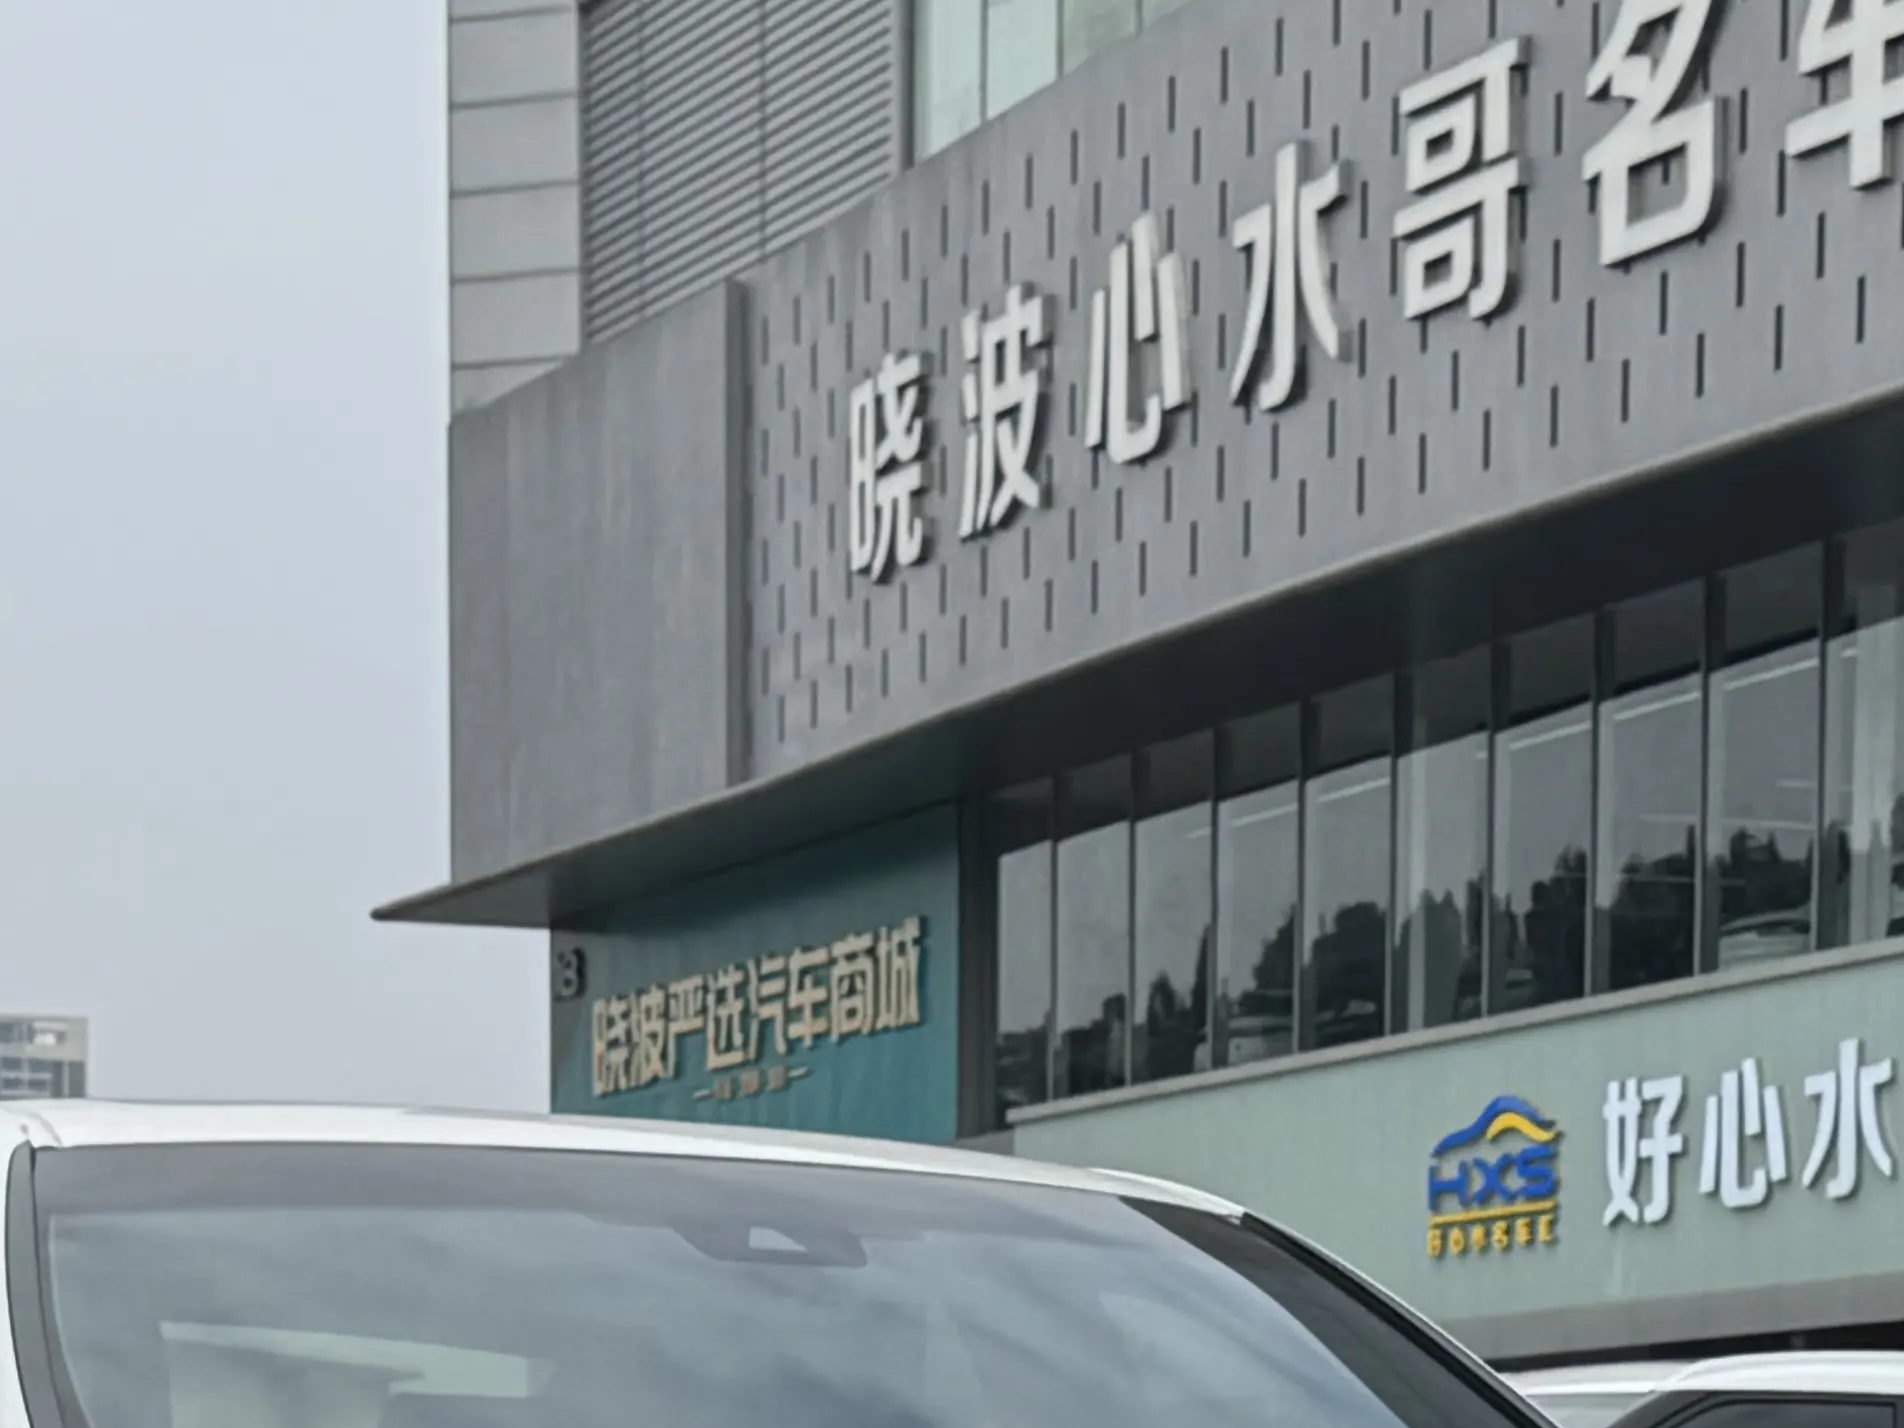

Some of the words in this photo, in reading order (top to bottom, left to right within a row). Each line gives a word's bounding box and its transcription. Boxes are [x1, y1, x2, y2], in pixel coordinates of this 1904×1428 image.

[592, 914, 922, 1098] 晓波严选汽车商城
[1428, 1144, 1557, 1213] HXS
